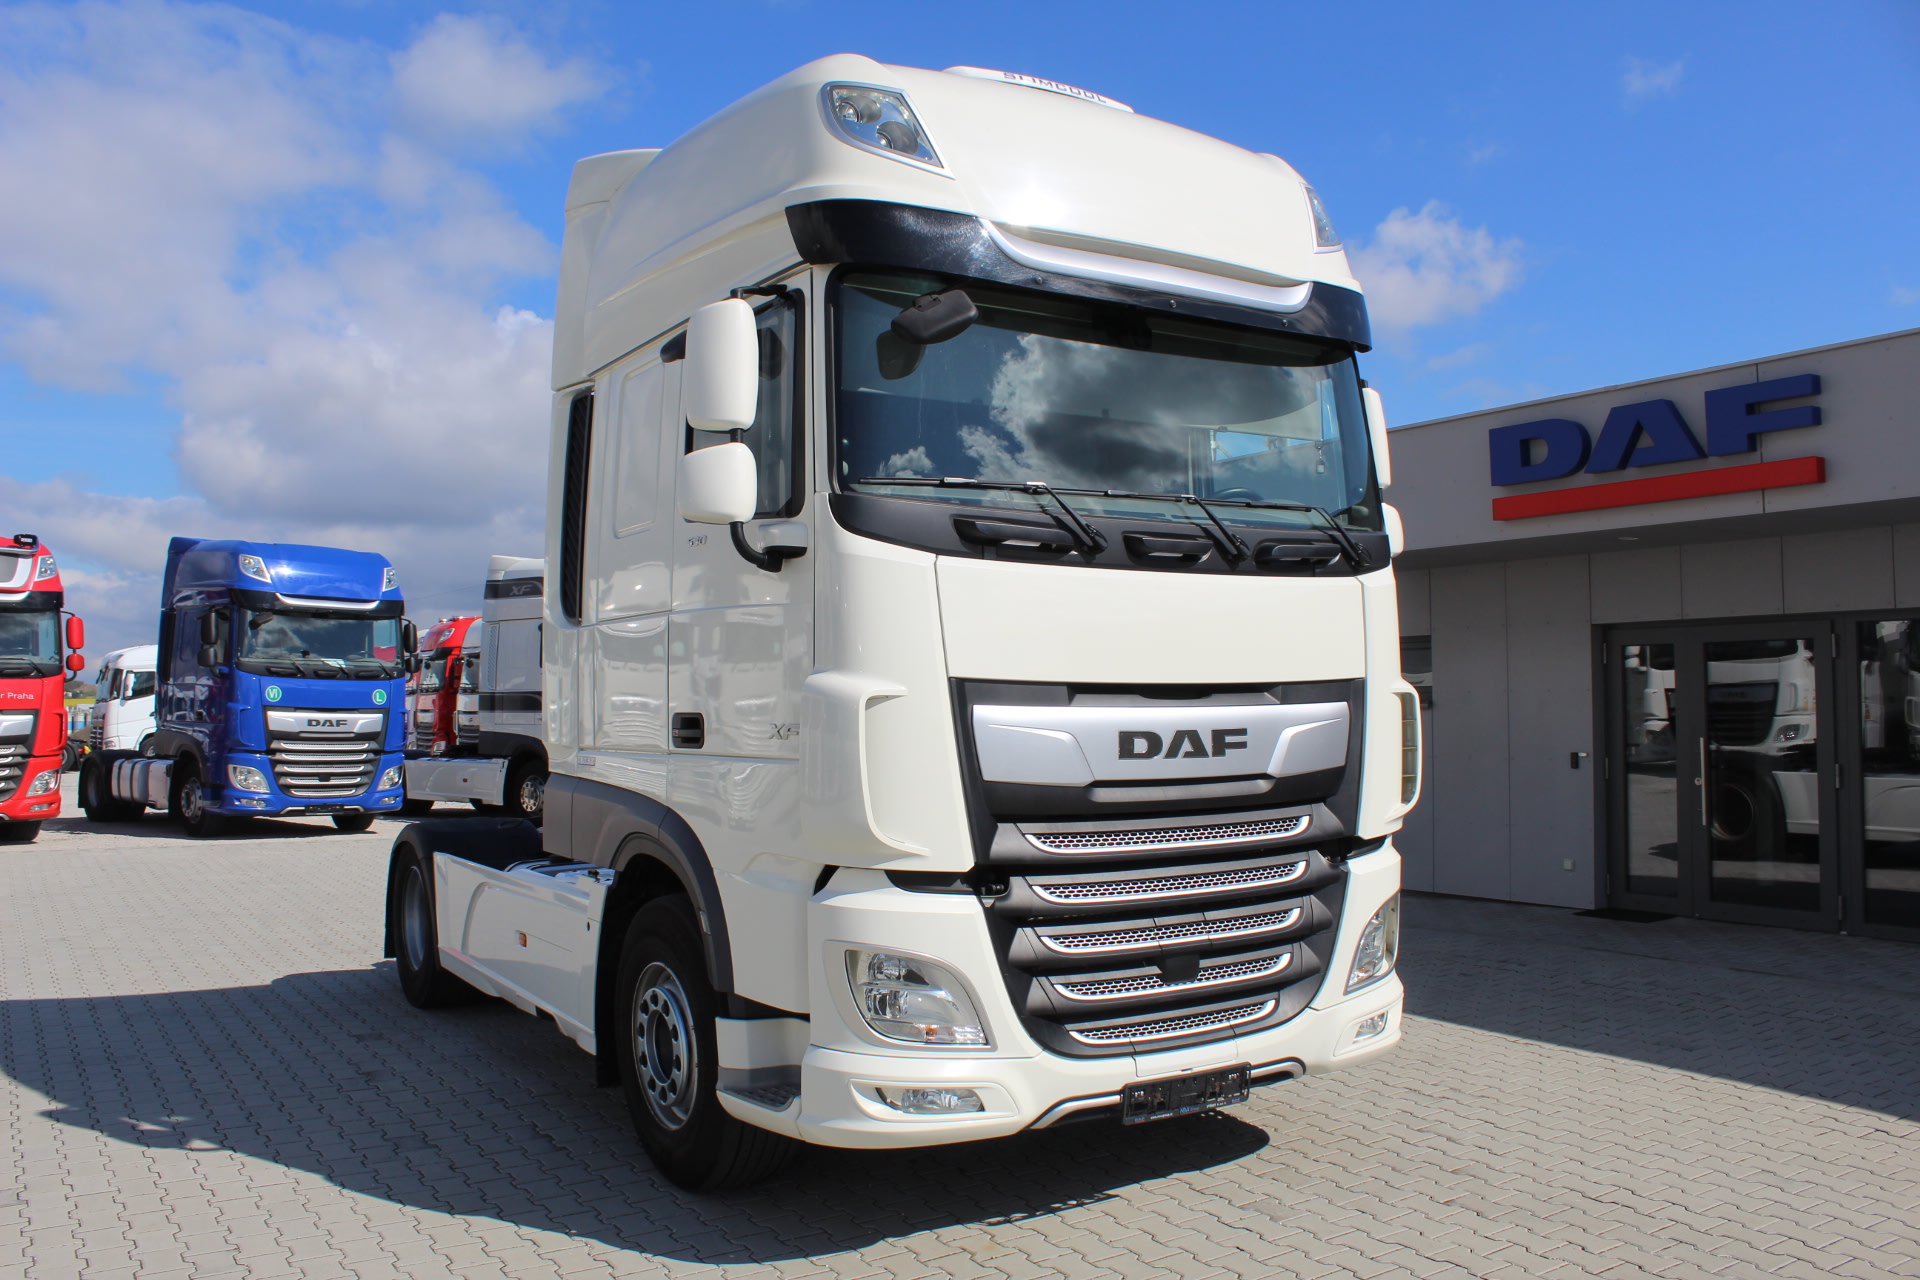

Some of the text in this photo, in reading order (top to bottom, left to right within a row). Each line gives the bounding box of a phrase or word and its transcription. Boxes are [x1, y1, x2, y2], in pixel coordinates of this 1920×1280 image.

[1489, 373, 1822, 487] DAF
[509, 584, 533, 596] XF
[7, 692, 35, 700] Praha
[307, 719, 348, 727] DAF
[768, 723, 801, 740] XF
[1118, 728, 1248, 760] DAF
